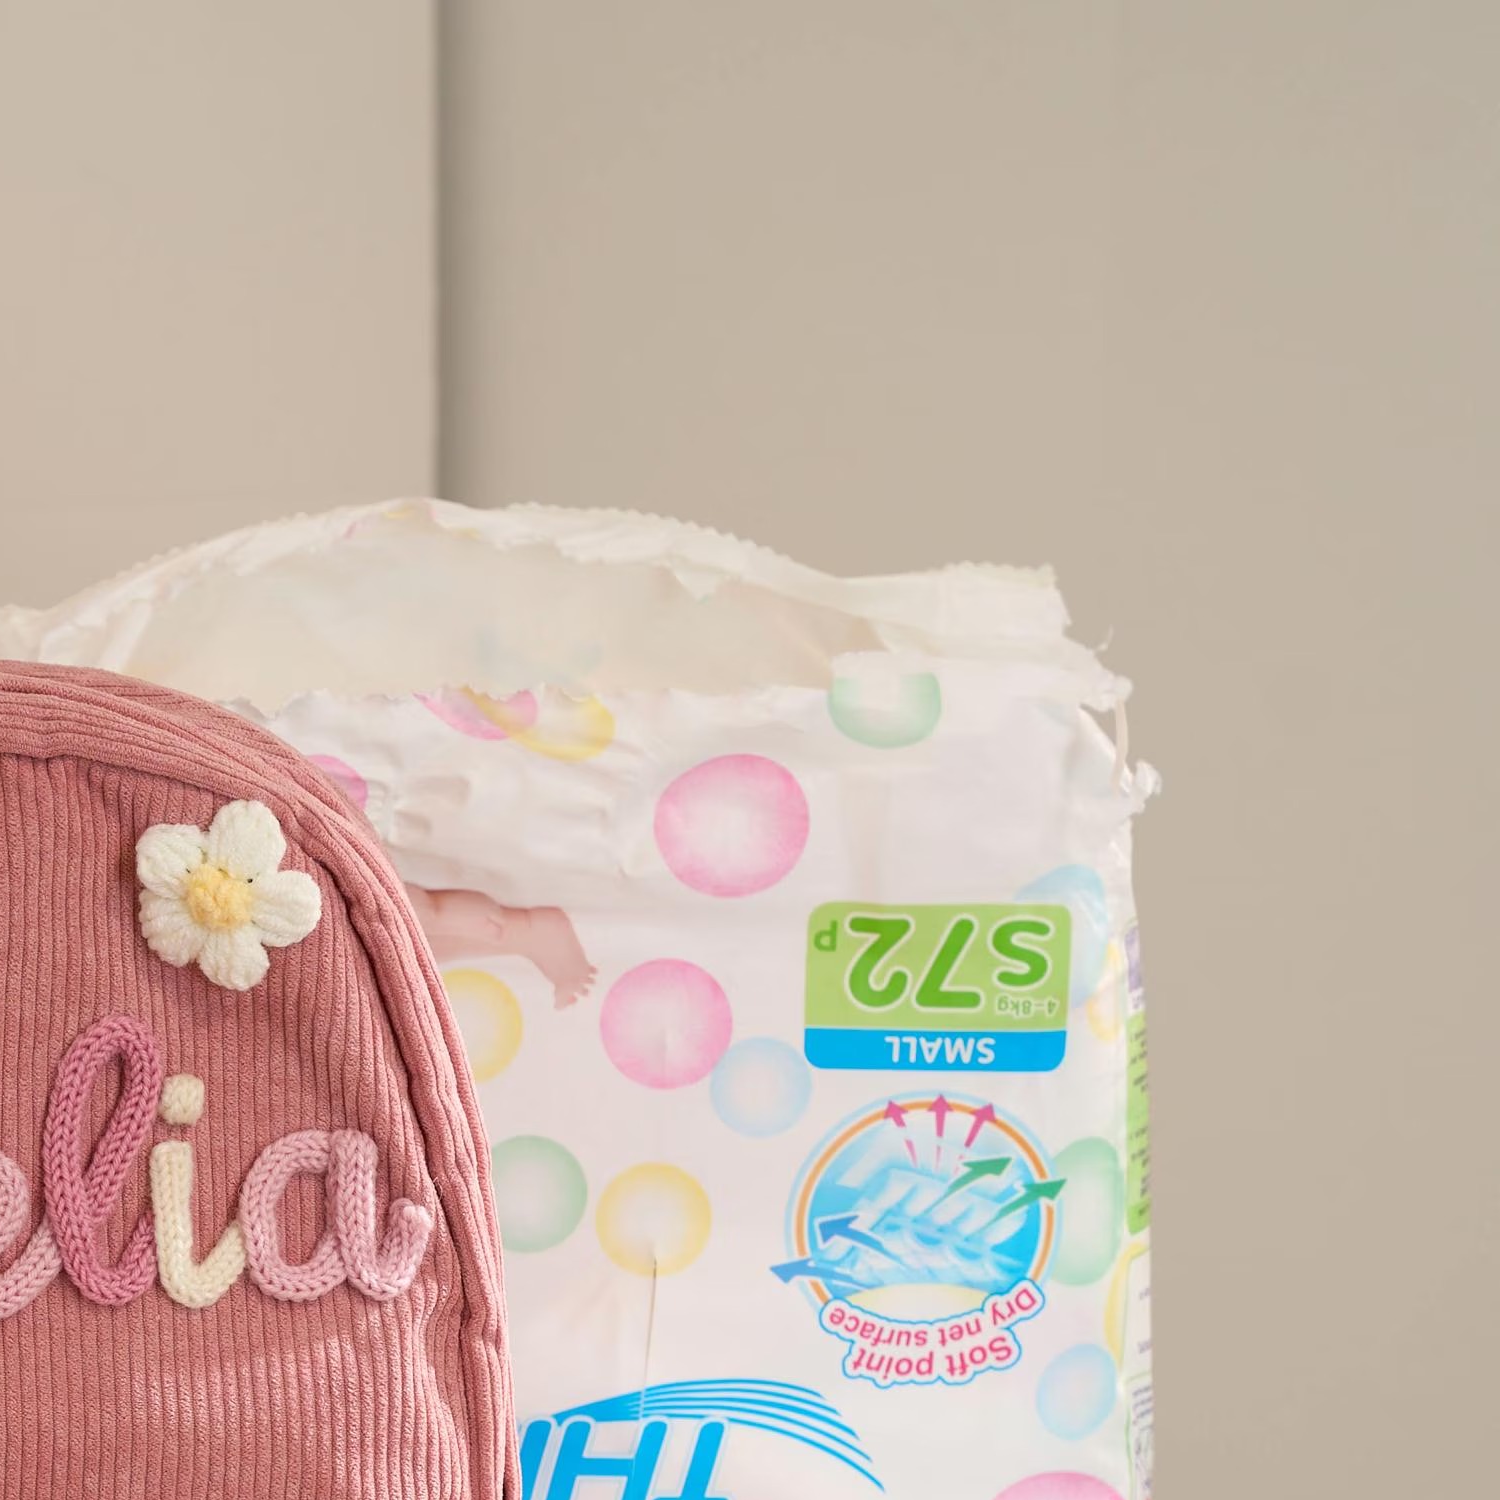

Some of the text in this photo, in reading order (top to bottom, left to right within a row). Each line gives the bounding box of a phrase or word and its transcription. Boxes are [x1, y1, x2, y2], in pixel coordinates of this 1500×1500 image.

[883, 1035, 997, 1065] SMALL
[828, 1287, 1038, 1347] Dry net surface
[852, 1336, 1013, 1380] Soft point
